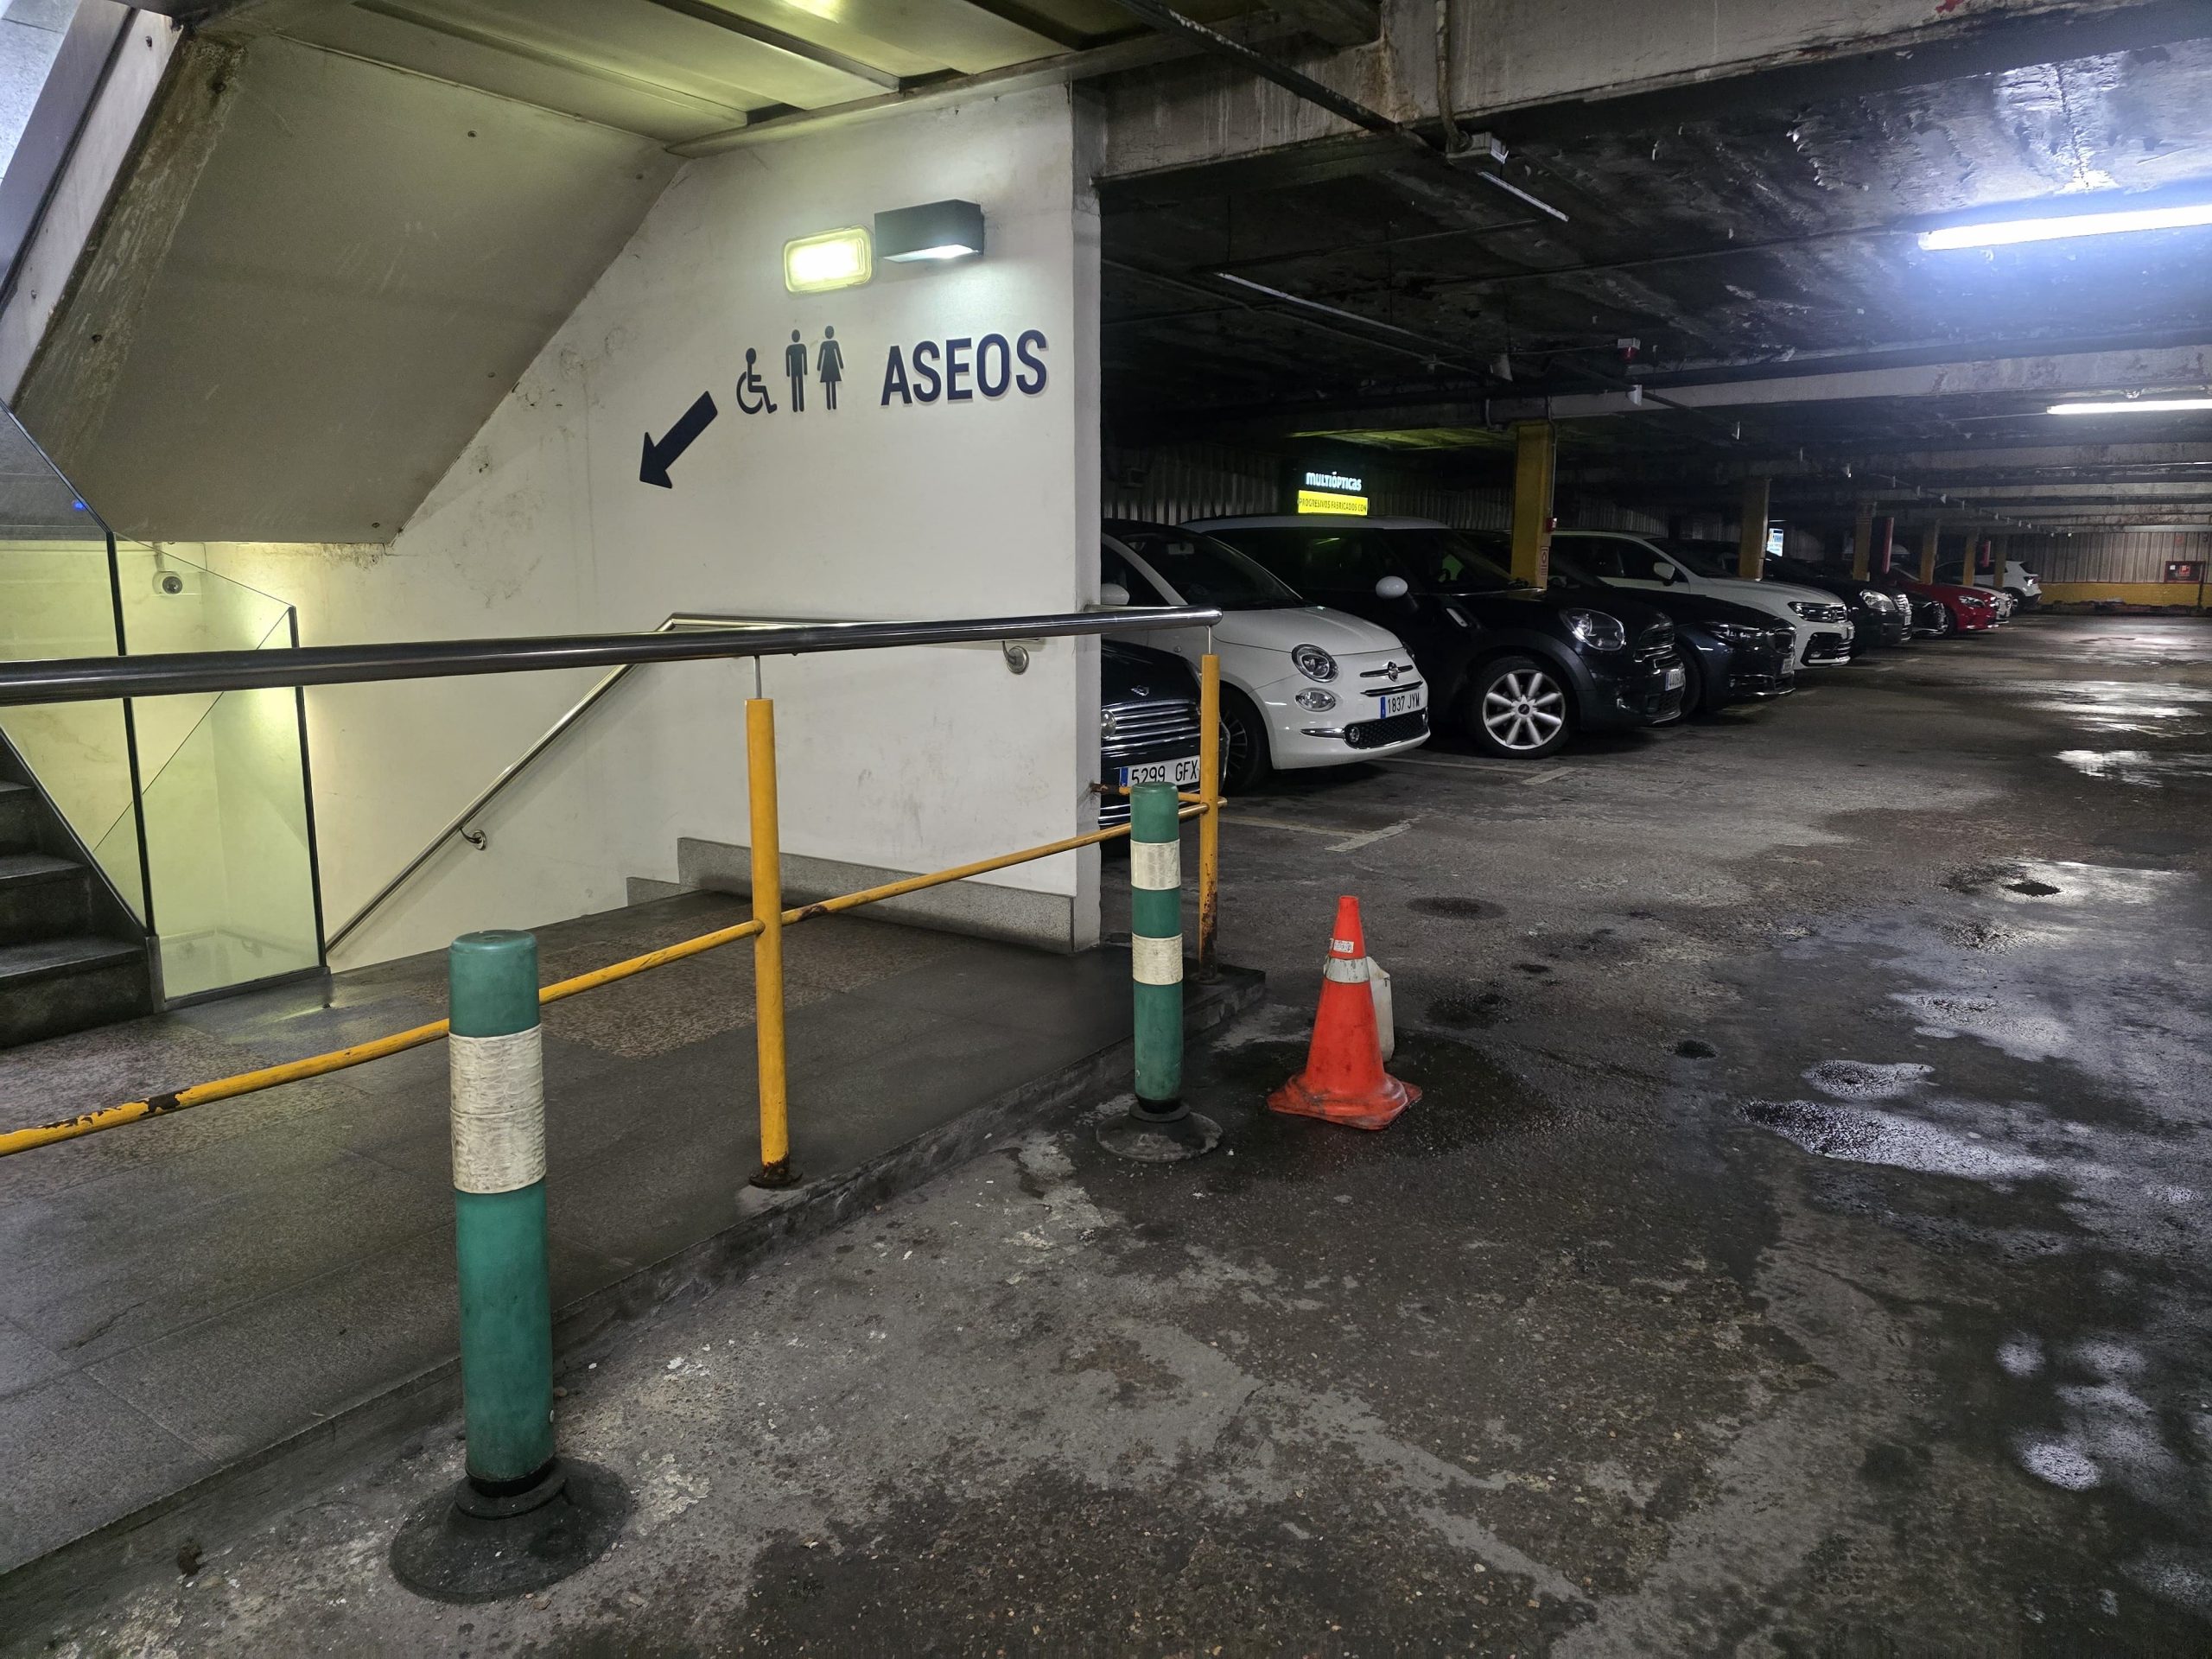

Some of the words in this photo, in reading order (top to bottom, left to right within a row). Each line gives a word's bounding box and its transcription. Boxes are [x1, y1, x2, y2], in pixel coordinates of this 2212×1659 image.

[880, 329, 1048, 405] ASEOS
[1331, 501, 1357, 512] FABRICADOS
[1388, 696, 1405, 714] 1837
[1131, 766, 1166, 784] 5299
[1175, 760, 1198, 782] GFX
